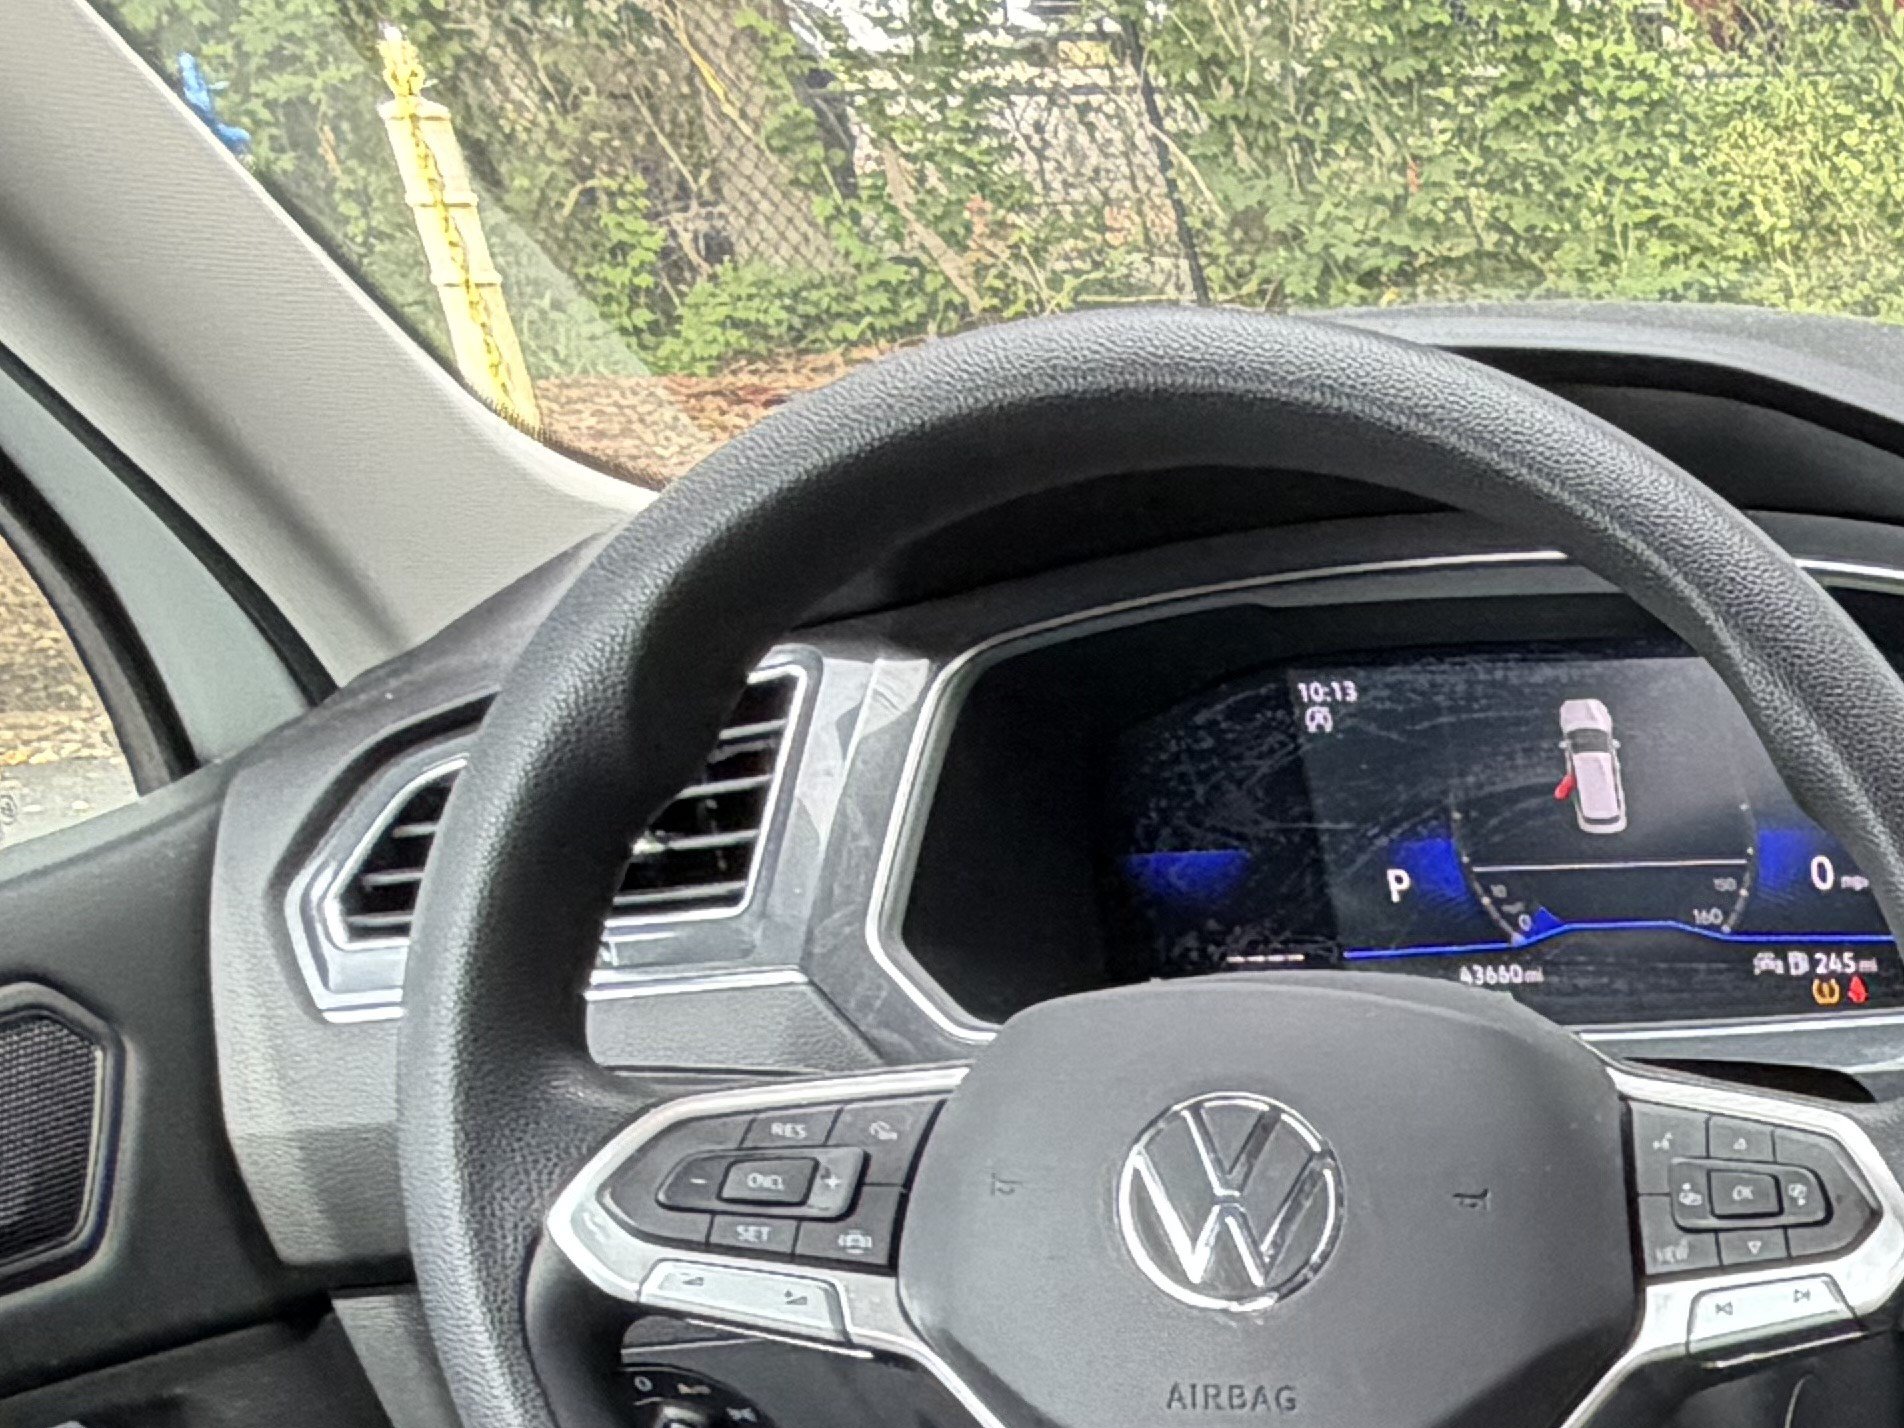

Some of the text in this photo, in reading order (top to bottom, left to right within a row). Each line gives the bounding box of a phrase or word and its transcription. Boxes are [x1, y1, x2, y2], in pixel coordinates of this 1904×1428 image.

[1297, 681, 1358, 702] 10:13
[1810, 855, 1835, 891] 0
[1386, 868, 1412, 903] P
[1814, 952, 1857, 974] 245
[770, 1122, 807, 1139] RES
[736, 1225, 771, 1241] SET
[1166, 1382, 1297, 1412] AIRBAG
